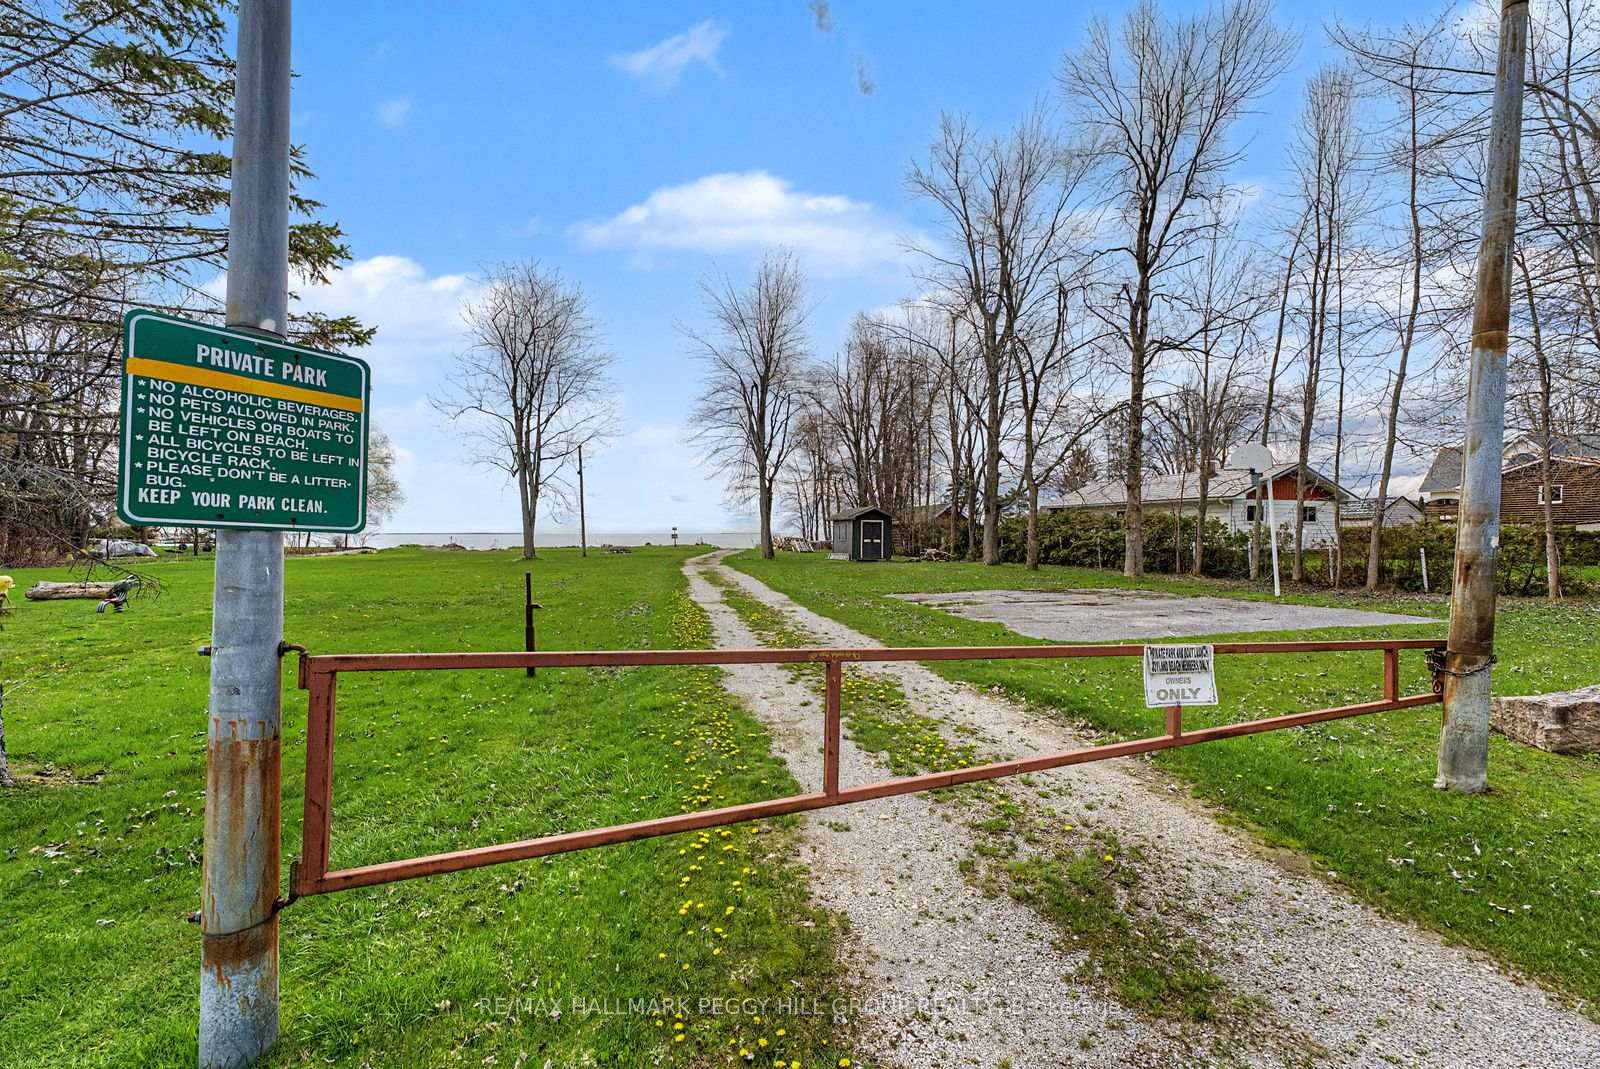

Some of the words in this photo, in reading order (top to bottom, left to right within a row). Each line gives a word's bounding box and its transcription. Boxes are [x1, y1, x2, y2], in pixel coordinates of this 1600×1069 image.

[197, 344, 274, 376] PRIVATE
[283, 362, 327, 387] PARK
[149, 393, 175, 406] NO
[180, 399, 221, 413] PETS
[227, 405, 297, 424] ALLOWED
[302, 417, 313, 427] IN
[319, 419, 355, 433] PARK.
[150, 380, 175, 393] NO
[182, 385, 272, 408] ALCOHOLIC
[278, 400, 358, 422] BEVERAGES.
[149, 407, 174, 419] NO
[180, 412, 256, 430] VEHICLES
[261, 423, 281, 434] OR
[287, 427, 331, 441] BOATS
[335, 433, 354, 444] TO
[149, 421, 173, 432] BE
[179, 425, 221, 438] LEFT
[227, 431, 249, 442] ON
[255, 435, 309, 450] BEACH.
[148, 435, 179, 447] ALL
[186, 439, 261, 456] BICYCLES
[267, 447, 285, 459] TO
[291, 451, 308, 461] BE
[313, 454, 344, 465] LEFT
[349, 458, 359, 467] IN
[148, 448, 222, 465] BICYCLE
[228, 457, 276, 470] RACK.
[146, 475, 186, 487] BUG.
[147, 462, 212, 477] PLEASE
[218, 467, 265, 481] DON'T
[269, 473, 287, 483] BE
[291, 475, 300, 484] A
[304, 477, 351, 489] LITTER-
[138, 488, 180, 504] KEEP
[192, 492, 230, 508] YOUR
[238, 495, 275, 511] PARK
[281, 498, 327, 513] CLEAN.
[1156, 688, 1201, 700] ONLY
